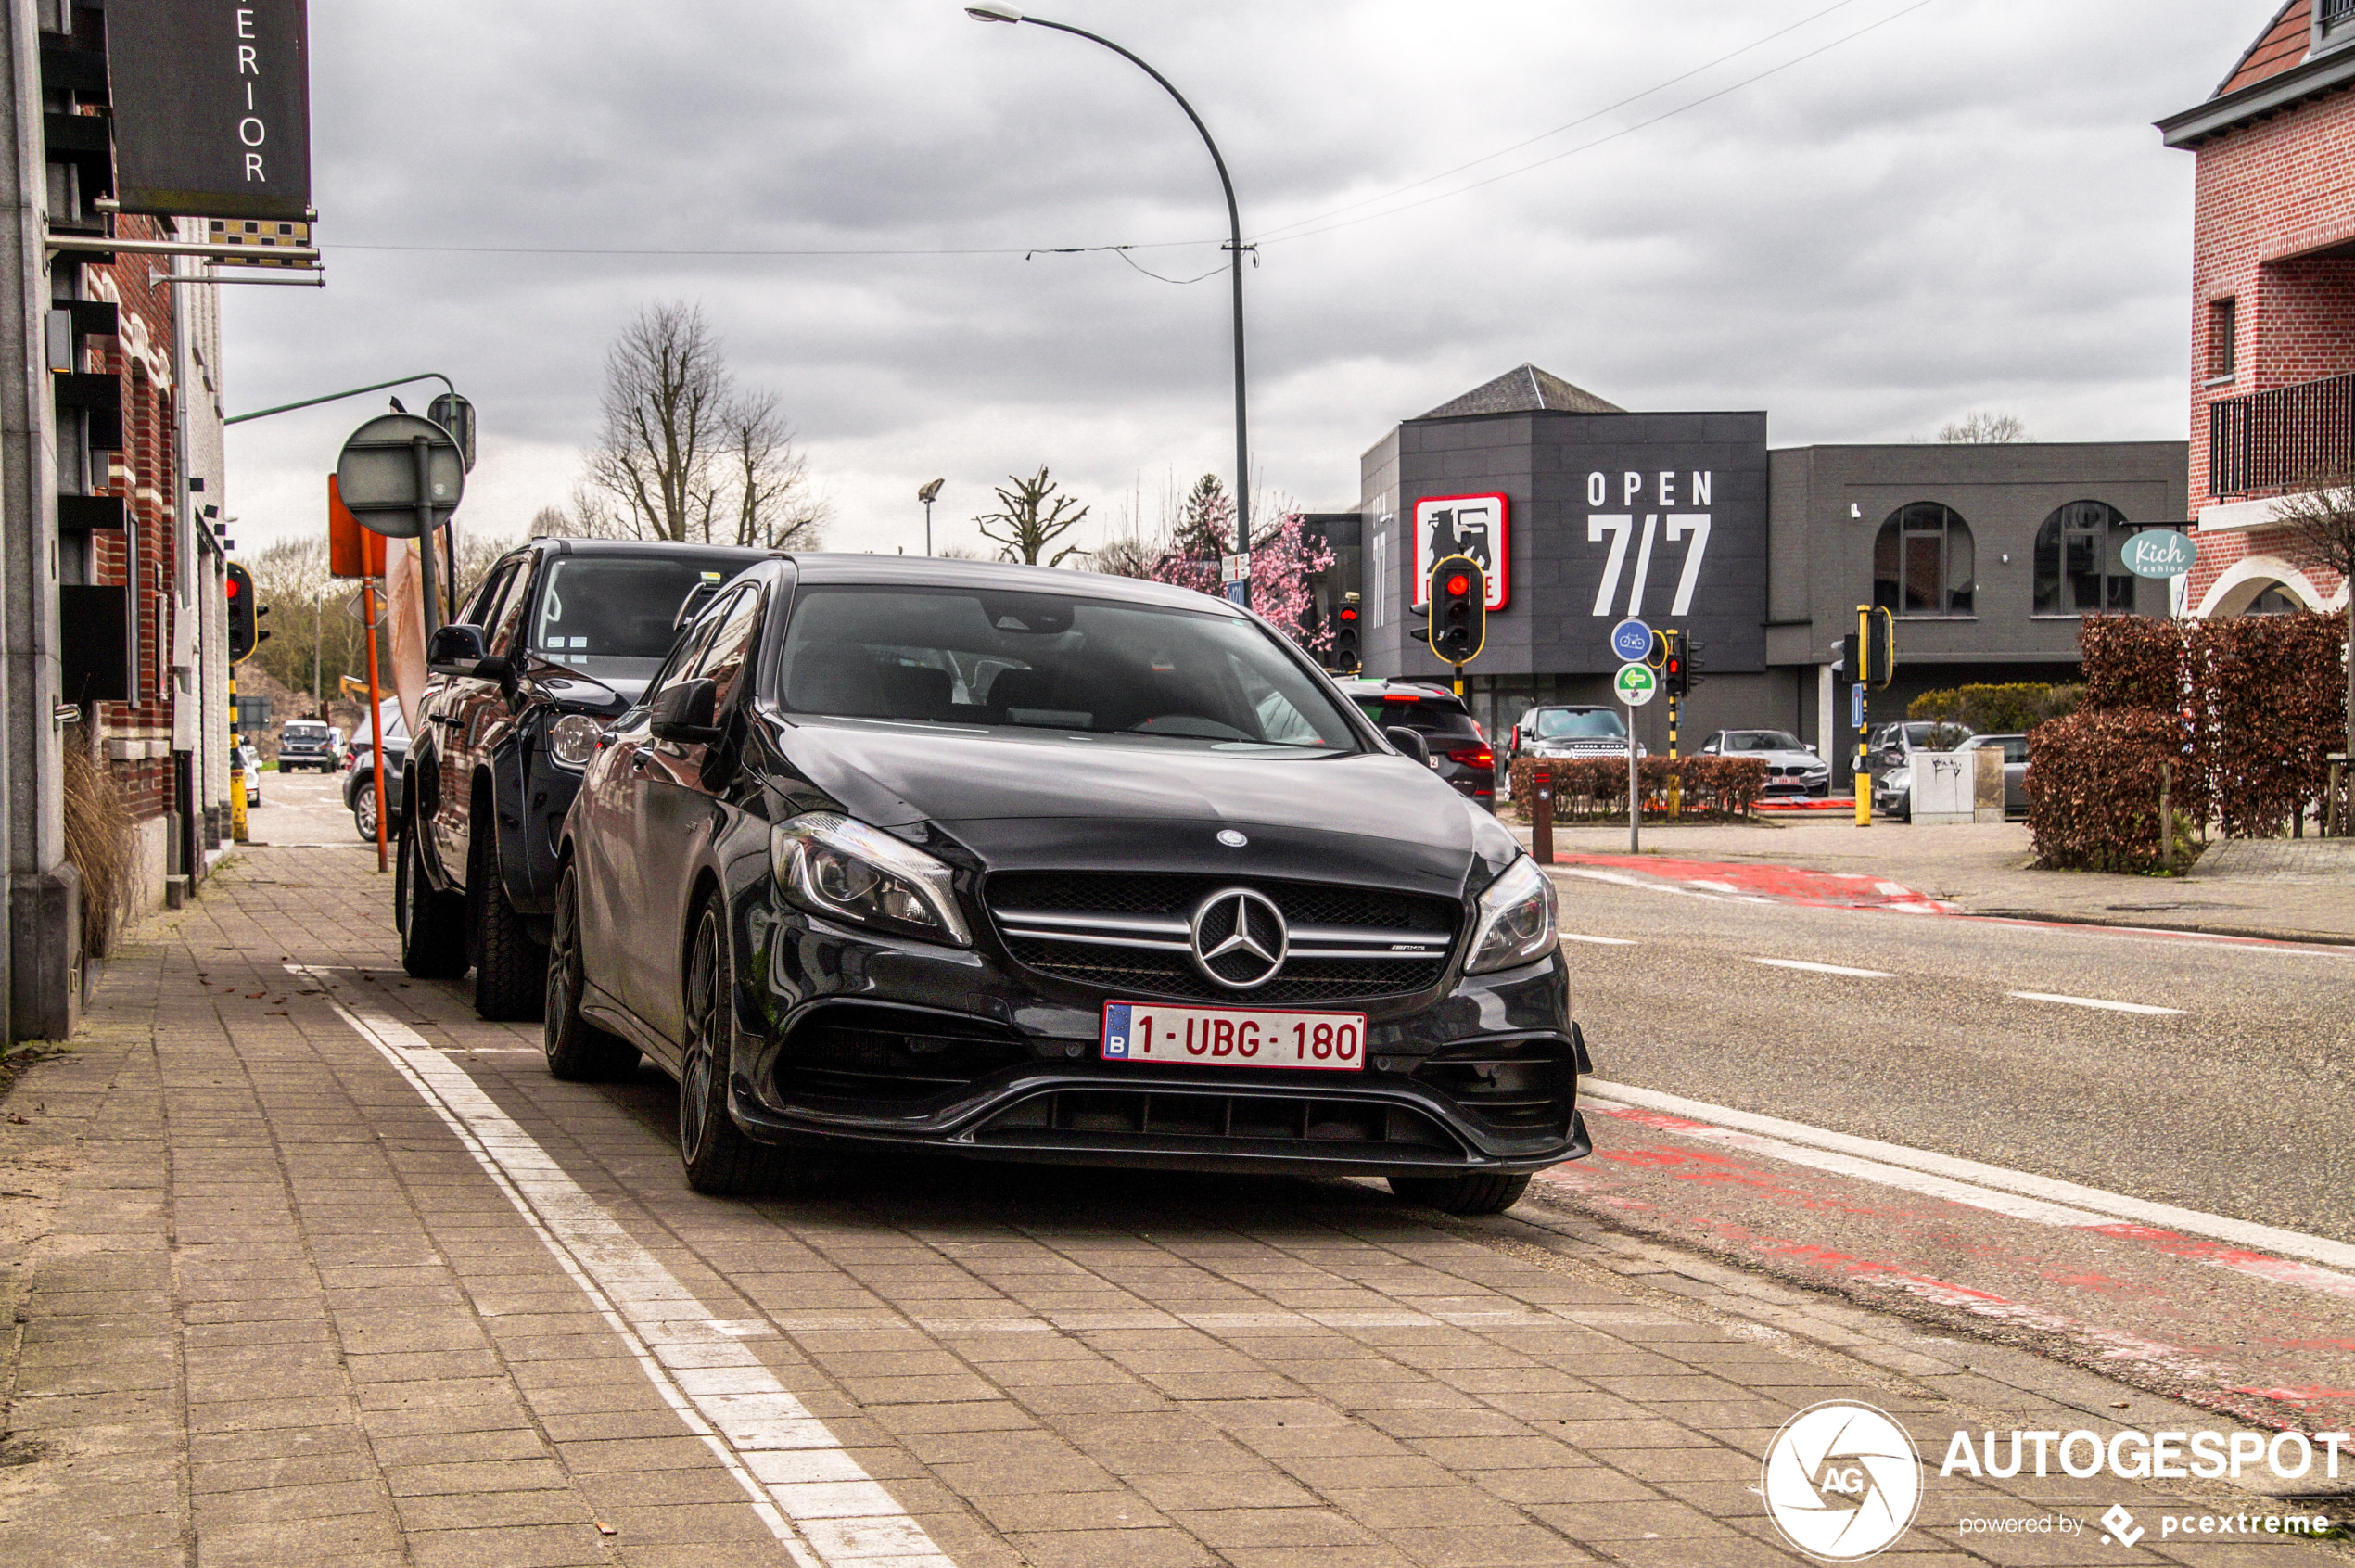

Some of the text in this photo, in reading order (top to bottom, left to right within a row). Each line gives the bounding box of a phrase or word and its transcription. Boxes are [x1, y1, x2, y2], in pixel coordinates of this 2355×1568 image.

[237, 0, 265, 182] ERIOR
[1587, 471, 1712, 507] OPEN
[1587, 514, 1712, 617] 7/7
[2135, 534, 2186, 565] Kich
[2136, 564, 2183, 573] fashion
[1109, 1035, 1126, 1054] B
[1139, 1015, 1357, 1061] 1-UBG-180
